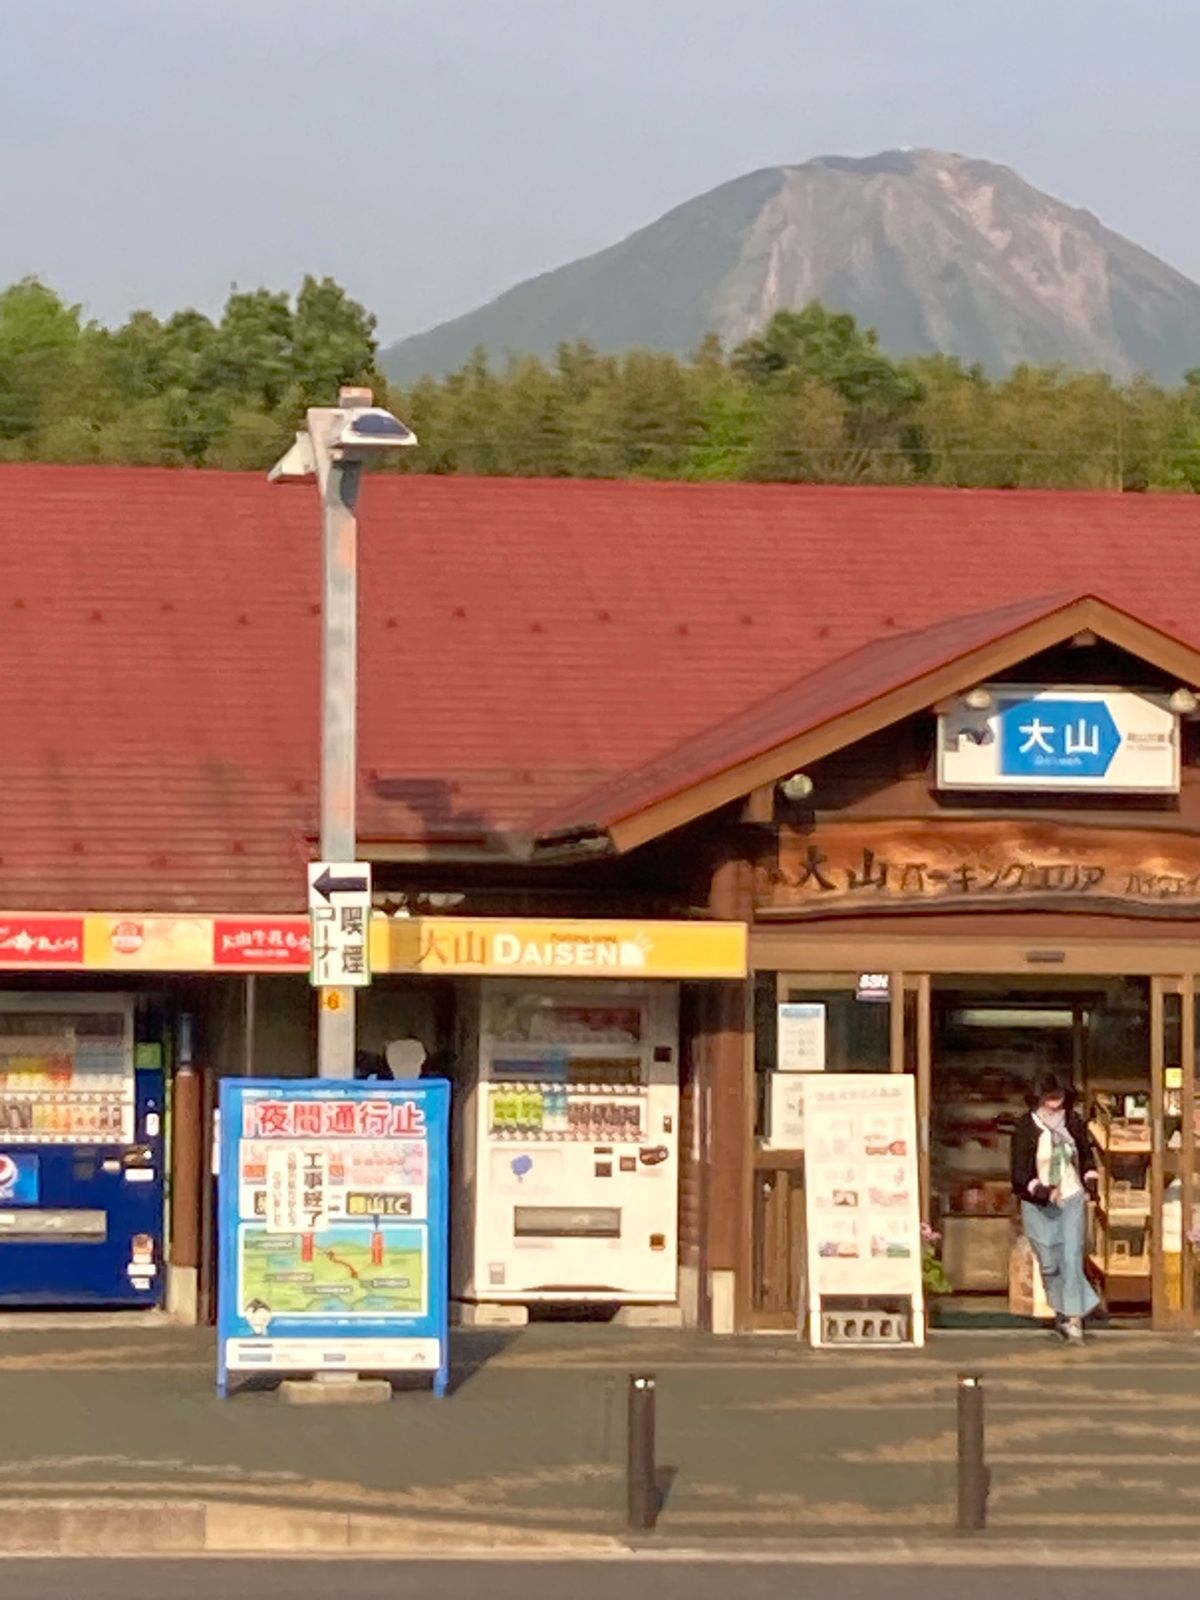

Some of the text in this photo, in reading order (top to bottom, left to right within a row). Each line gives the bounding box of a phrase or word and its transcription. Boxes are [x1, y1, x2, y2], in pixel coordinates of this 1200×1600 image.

[1018, 717, 1099, 755] 大山
[315, 906, 337, 979] コーナー
[416, 928, 619, 968] 大山 DAISEN
